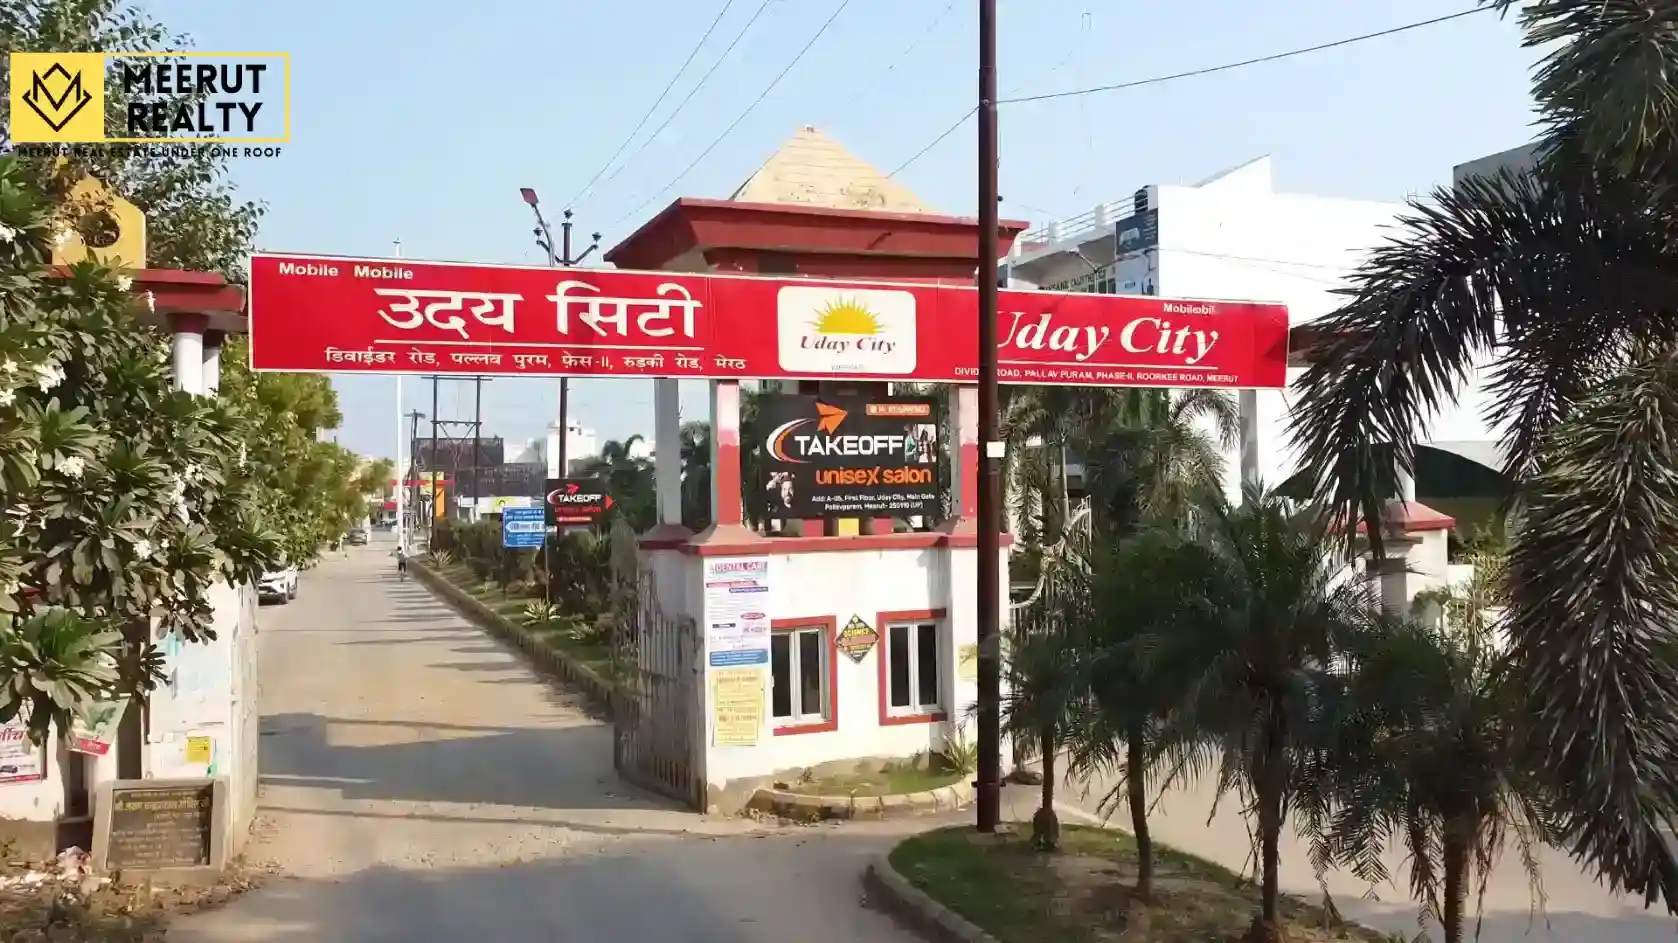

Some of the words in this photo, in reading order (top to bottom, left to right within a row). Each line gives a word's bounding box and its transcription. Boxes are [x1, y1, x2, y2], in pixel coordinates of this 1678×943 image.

[279, 262, 339, 277] Mobile
[354, 265, 414, 280] Mobile
[373, 287, 525, 339] उदय
[544, 280, 704, 338] सिटी
[800, 335, 850, 354] Uday
[856, 336, 896, 354] City
[1120, 317, 1219, 364] City
[325, 346, 396, 366] डिवाईडर
[407, 347, 440, 367] रोड,
[450, 353, 502, 366] पल्लव
[512, 354, 551, 369] पुरम,
[675, 353, 703, 371] रोड,
[714, 354, 747, 370] मेरठ
[1024, 369, 1058, 378] PALLAV
[1060, 370, 1093, 379] PURAM,
[1136, 373, 1178, 382] ROORKEE
[1206, 374, 1239, 383] MEERUT
[794, 435, 903, 456] TAKEOFF
[816, 466, 880, 485] unisex
[883, 466, 932, 485] salon
[558, 494, 602, 503] TAKEOFF
